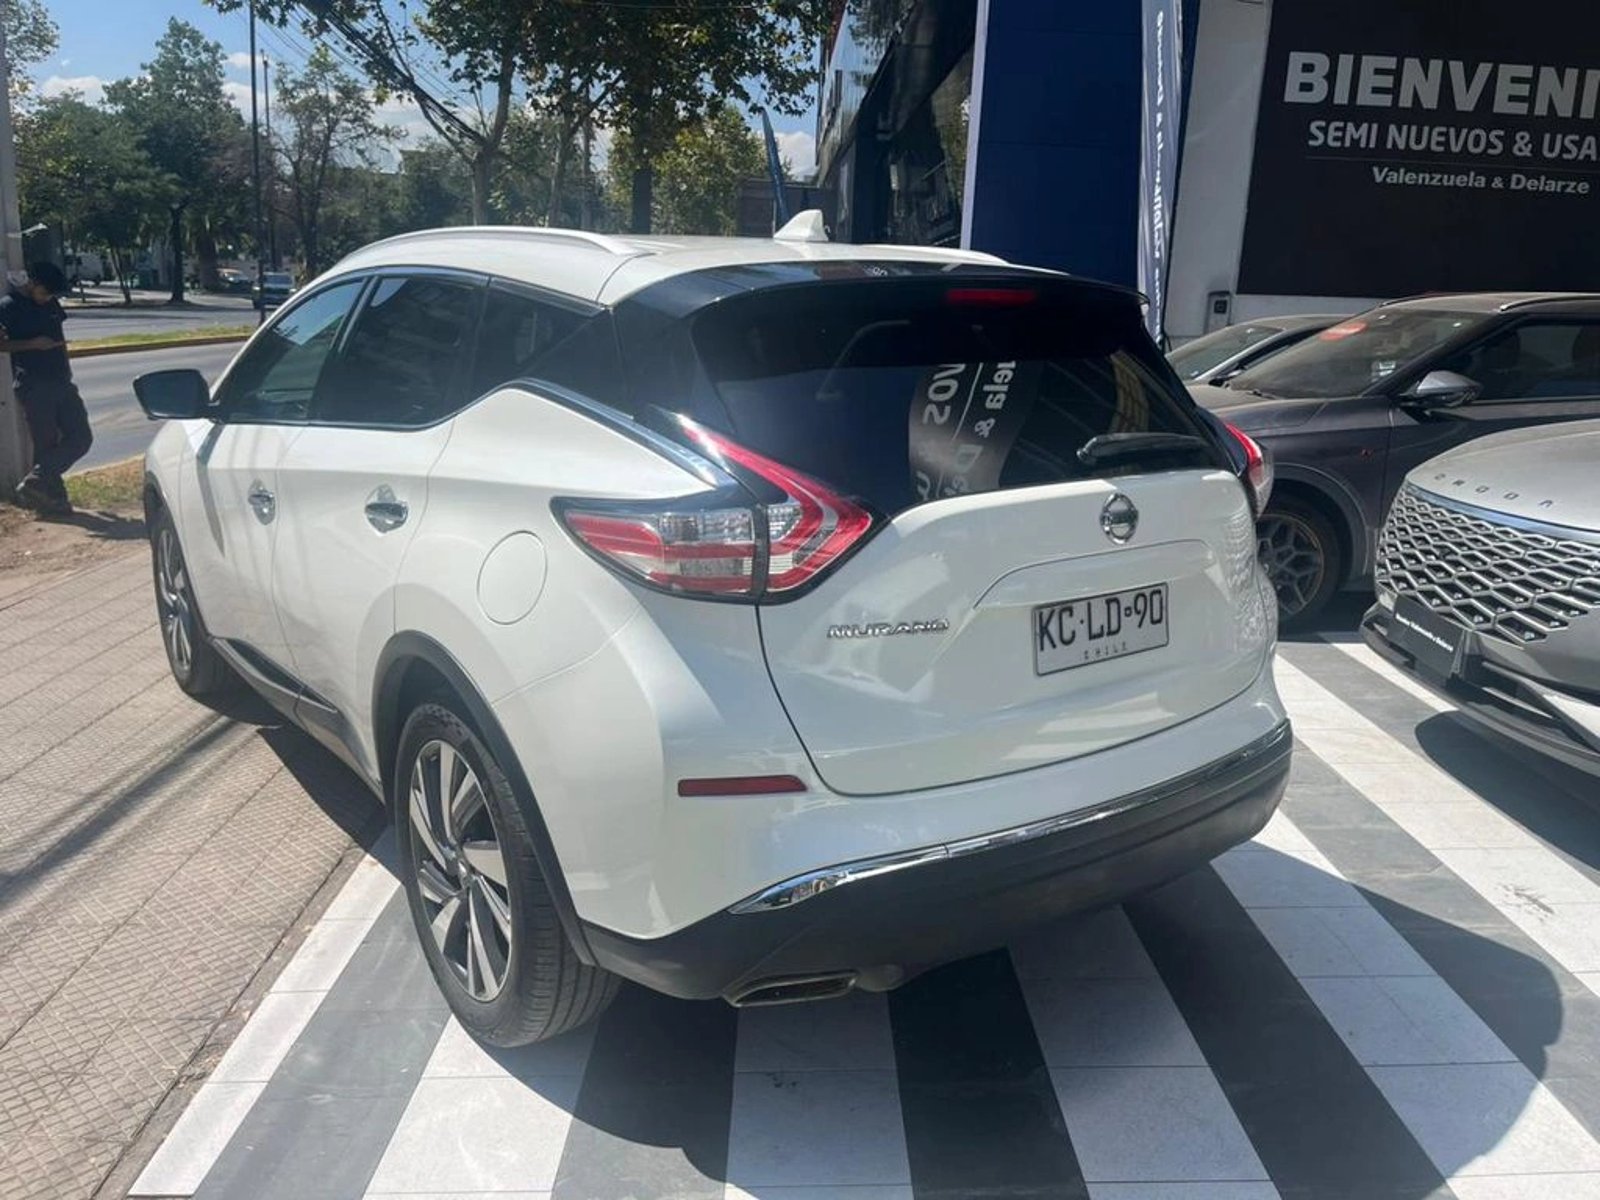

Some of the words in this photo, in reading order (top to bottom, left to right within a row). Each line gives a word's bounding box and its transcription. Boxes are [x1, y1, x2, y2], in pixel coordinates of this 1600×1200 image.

[1283, 50, 1600, 119] BIENVENI
[1308, 120, 1379, 149] SEMI
[1386, 124, 1505, 156] NUEVOS
[1512, 131, 1534, 158] &
[1372, 165, 1486, 189] Valenzuela
[1491, 176, 1505, 190] &
[1510, 173, 1591, 195] Delarze
[826, 618, 950, 639] MURANO
[1083, 641, 1128, 661] CHILE
